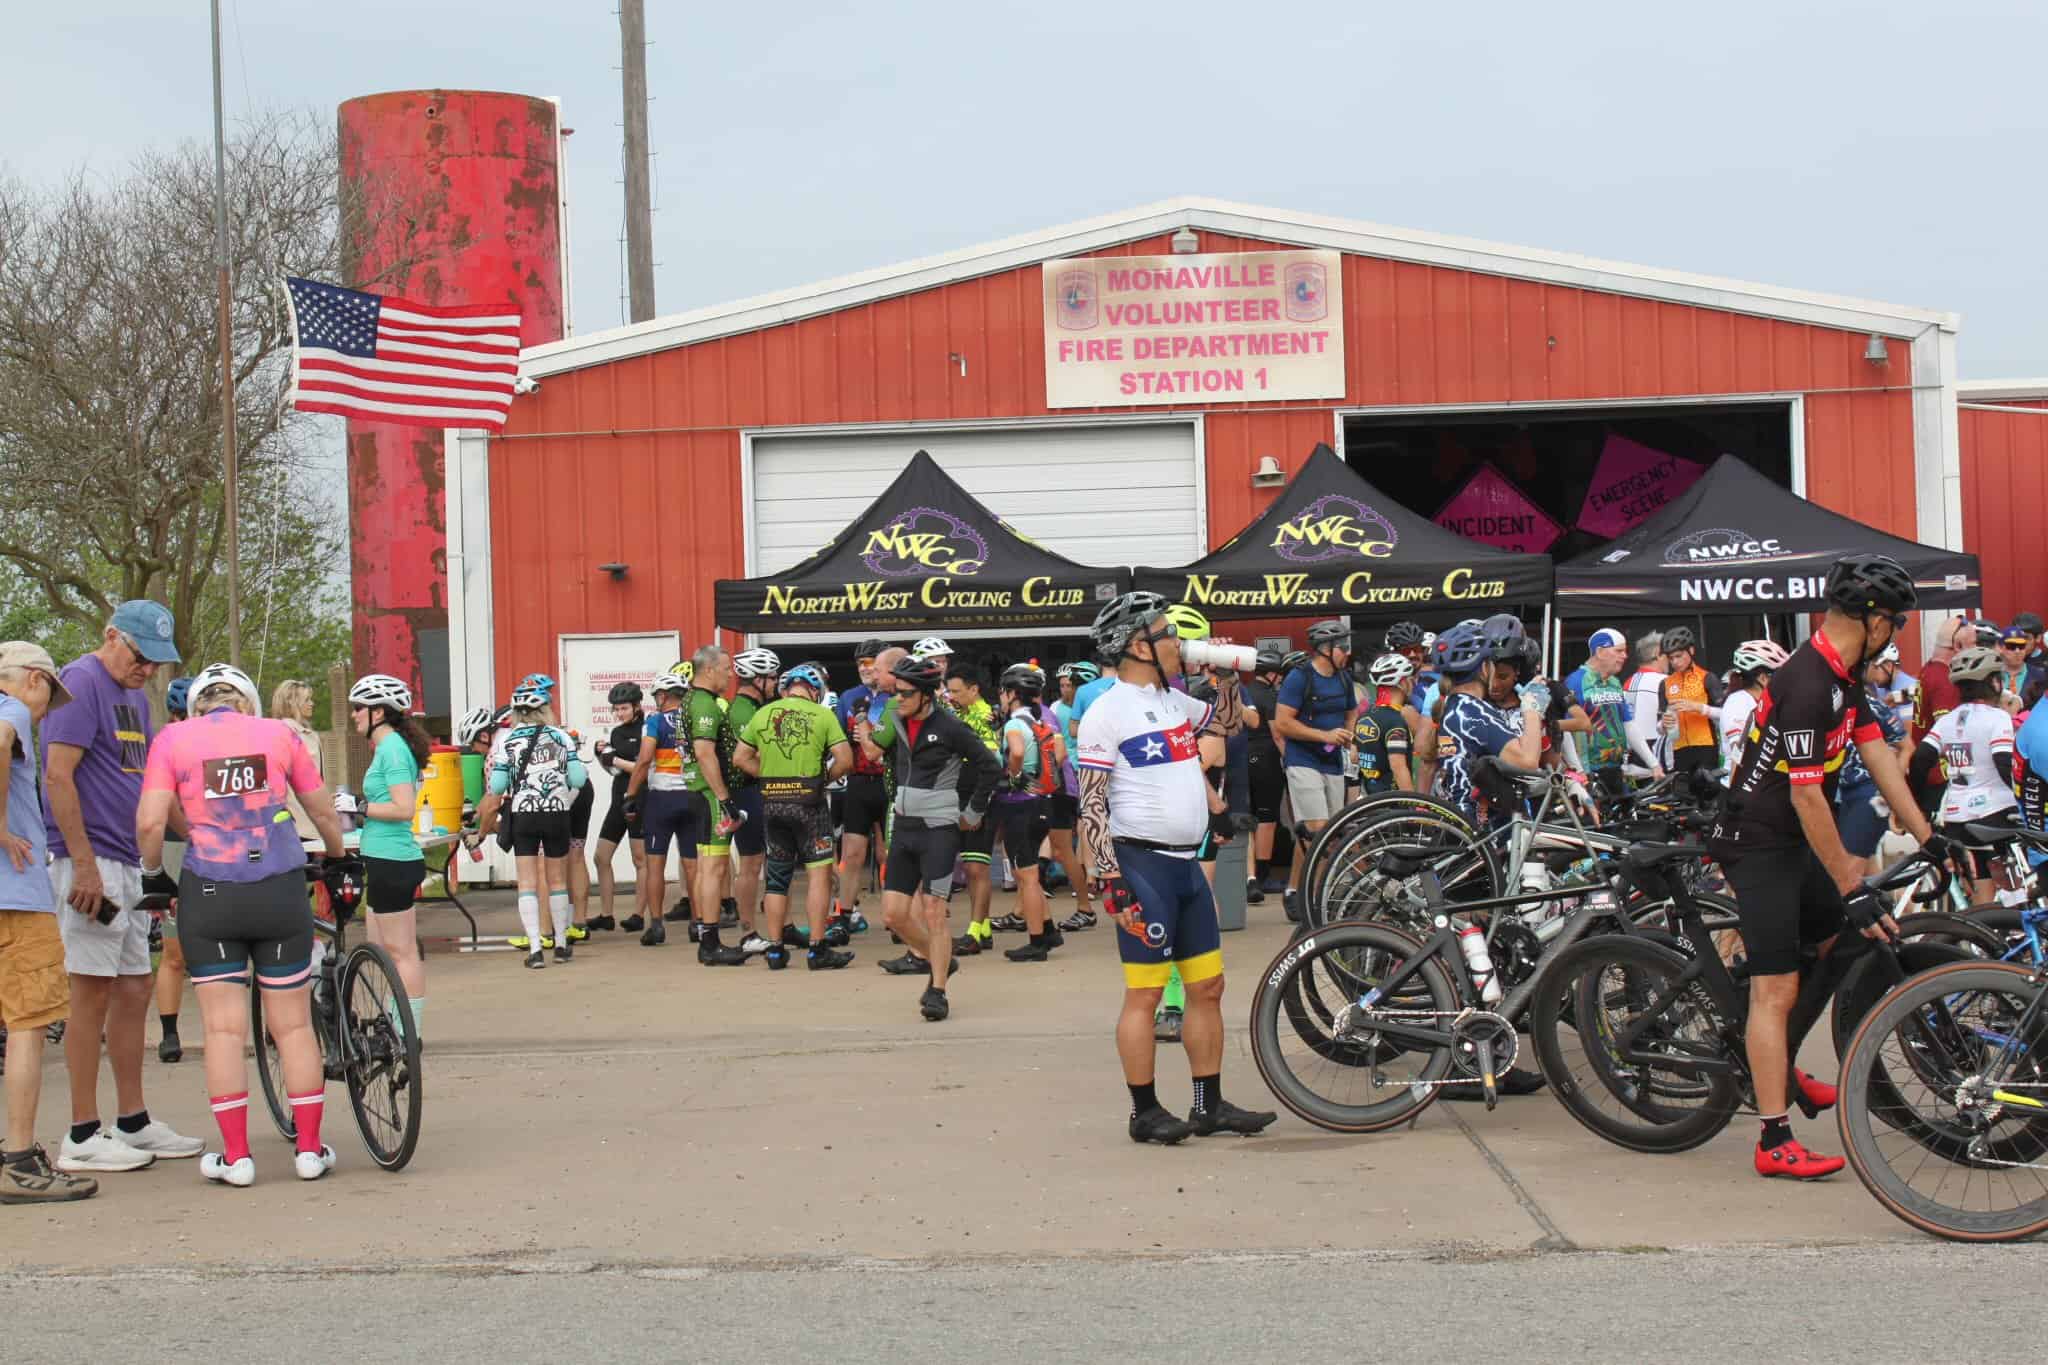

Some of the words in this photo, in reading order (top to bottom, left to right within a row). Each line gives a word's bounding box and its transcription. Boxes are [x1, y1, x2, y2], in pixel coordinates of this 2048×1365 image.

[1107, 264, 1276, 292] MONAVILLE
[1105, 299, 1281, 326] VOLUNTEER
[1058, 338, 1123, 363] FIRE
[1133, 331, 1329, 361] DEPARTMENT
[1120, 368, 1244, 396] STATION
[1253, 367, 1268, 391] 1
[1590, 457, 1679, 512] EMERGENCY
[1621, 487, 1669, 522] SCENE
[859, 523, 983, 576] NWCC
[1270, 513, 1394, 558] NWCC
[1688, 539, 1781, 560] NWCC
[921, 576, 1012, 610] CYCLING
[1021, 576, 1085, 608] CLUB
[1341, 571, 1433, 604] CYCLING
[1442, 568, 1505, 600] CLUB
[1945, 749, 1969, 766] 1196
[217, 766, 255, 793] 768
[1298, 938, 1316, 958] DT
[1268, 952, 1297, 988] SWISS
